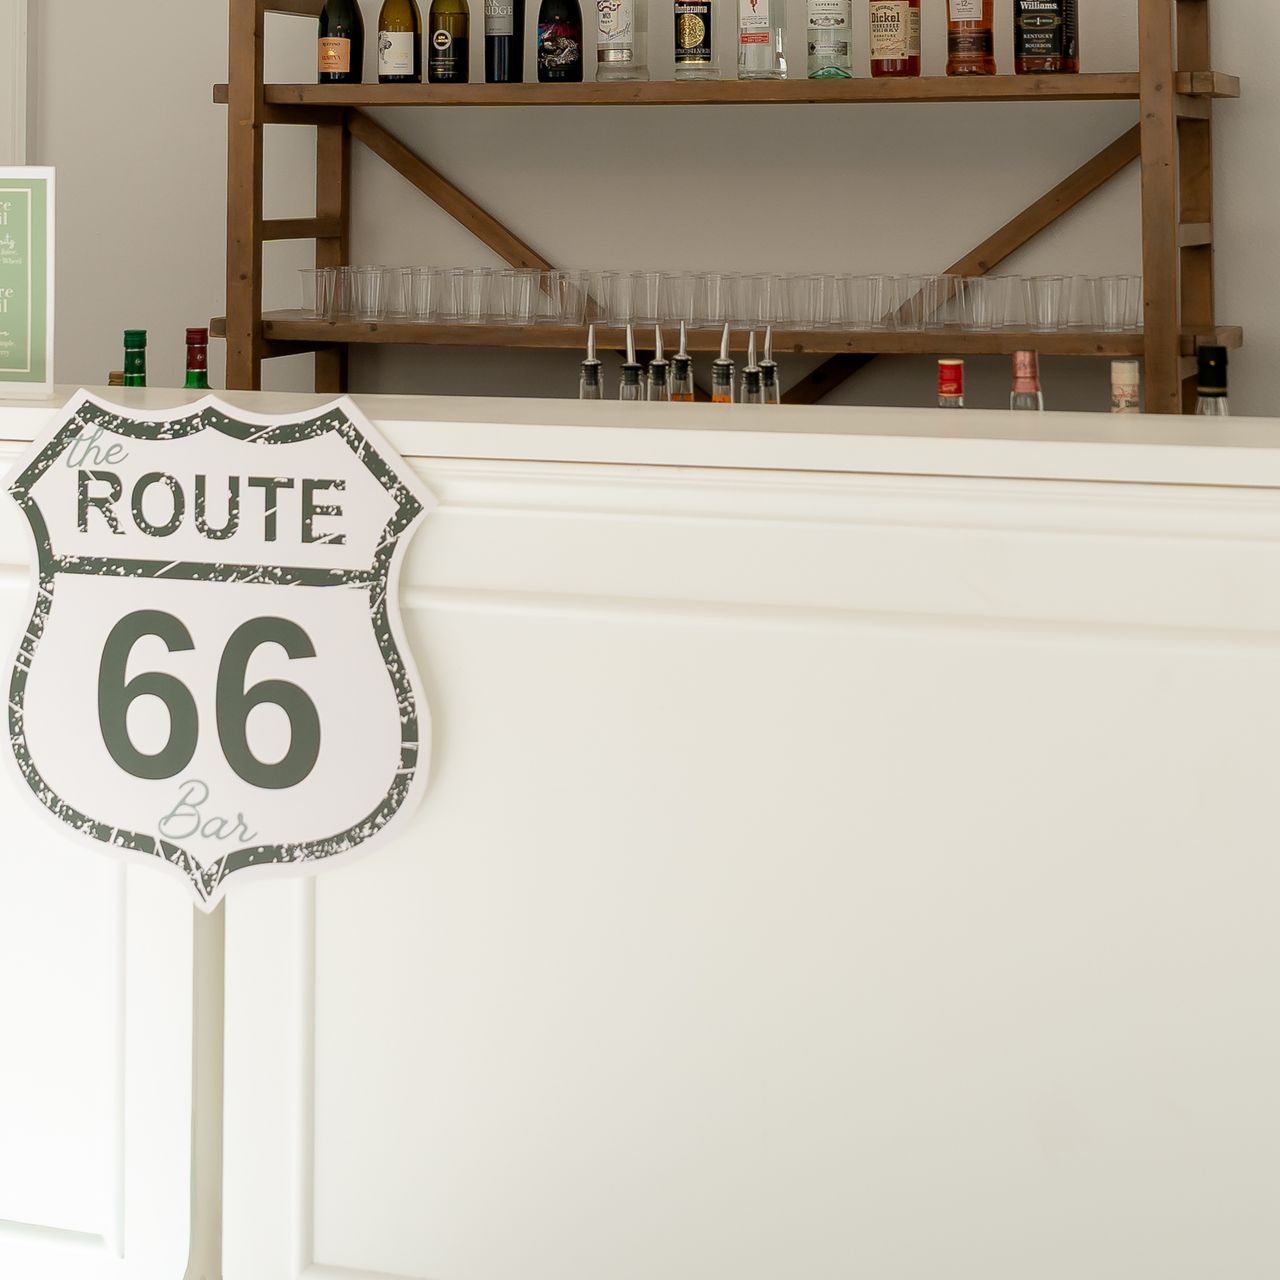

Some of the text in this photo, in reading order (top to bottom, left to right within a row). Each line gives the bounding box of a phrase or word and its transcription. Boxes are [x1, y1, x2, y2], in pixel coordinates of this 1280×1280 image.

[871, 12, 900, 23] Dickel
[65, 426, 129, 468] the
[77, 470, 347, 545] ROUTE
[97, 609, 322, 790] 66
[157, 779, 259, 843] Bar
